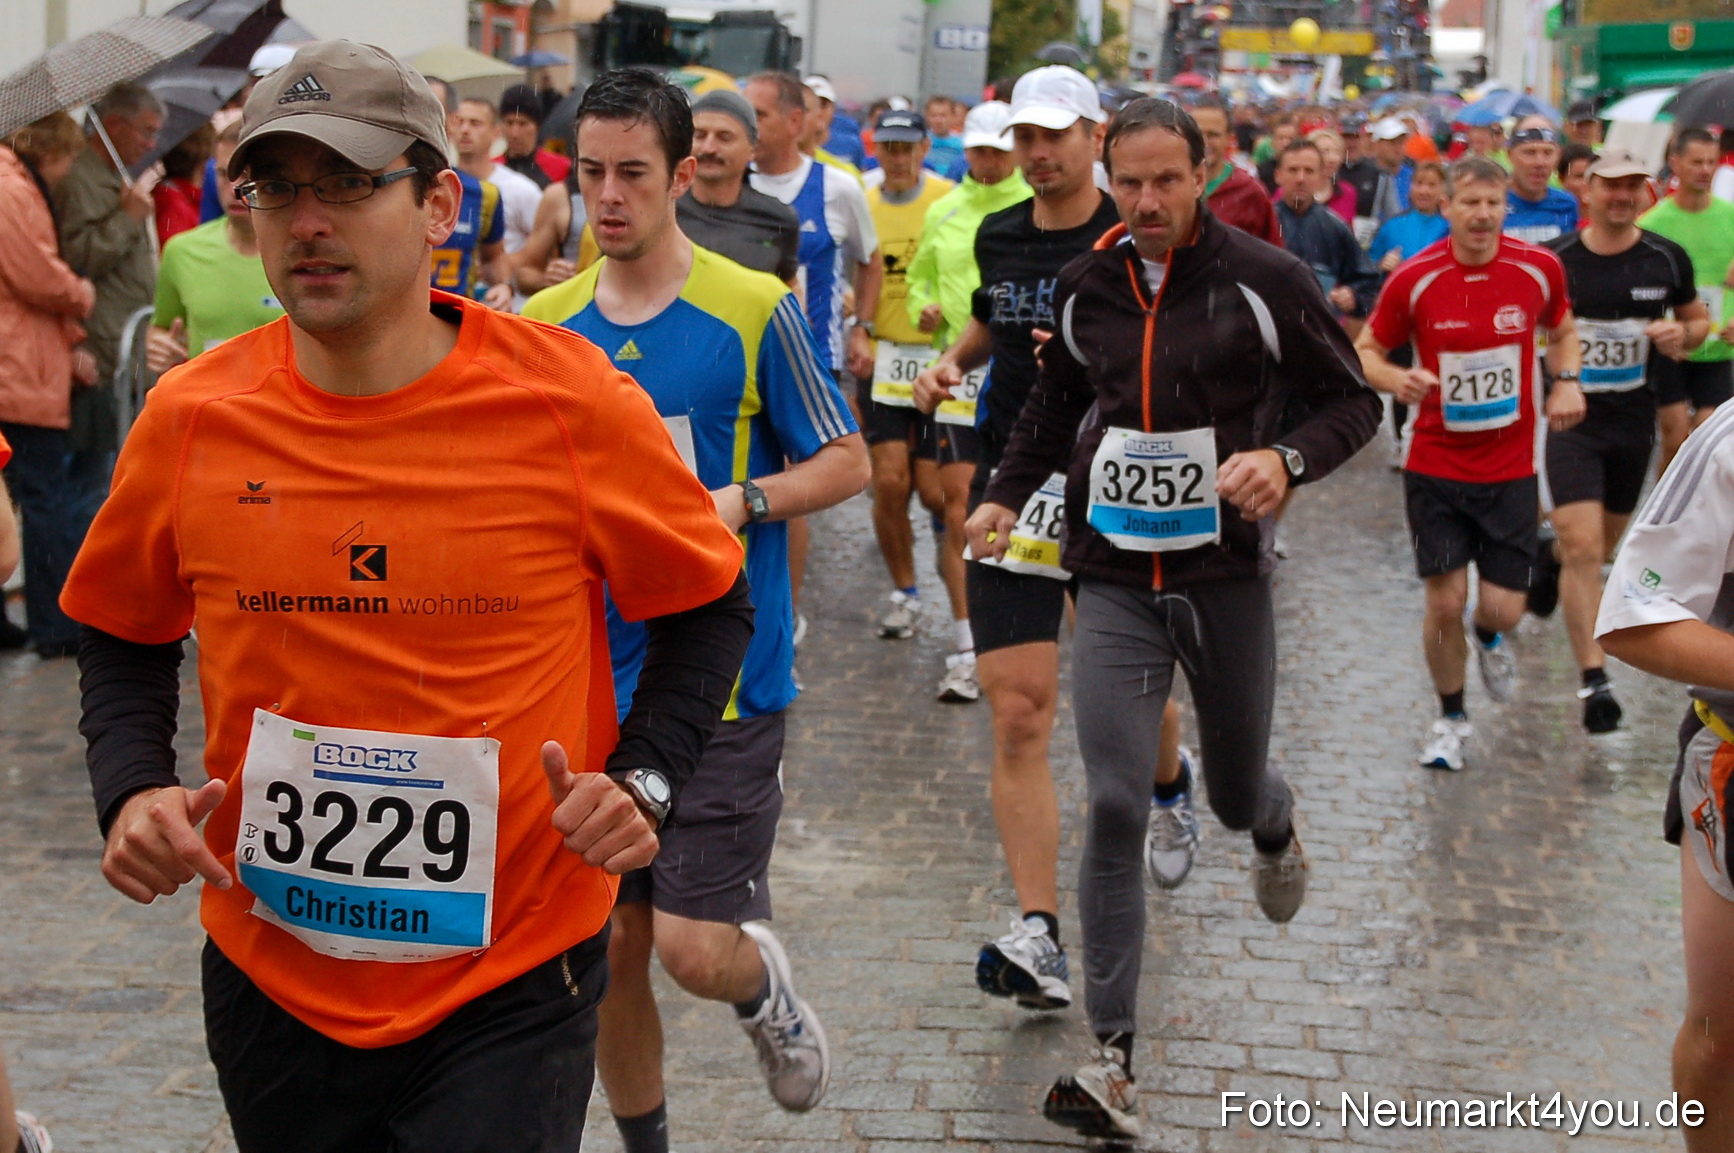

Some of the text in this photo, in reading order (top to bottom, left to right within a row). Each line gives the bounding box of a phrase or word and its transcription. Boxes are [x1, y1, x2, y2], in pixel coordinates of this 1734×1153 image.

[278, 92, 331, 104] adidas
[1580, 340, 1639, 366] 2331
[890, 359, 927, 381] 30
[1448, 368, 1514, 401] 2128
[1124, 439, 1173, 453] BOCK
[1102, 460, 1204, 508] 3252
[238, 496, 271, 505] erima
[1014, 500, 1064, 539] 48
[1122, 514, 1182, 534] Johann
[236, 590, 519, 615] kellermann wohnbau
[314, 743, 418, 772] BOCK
[263, 780, 471, 883] 3229
[285, 886, 429, 934] Christian
